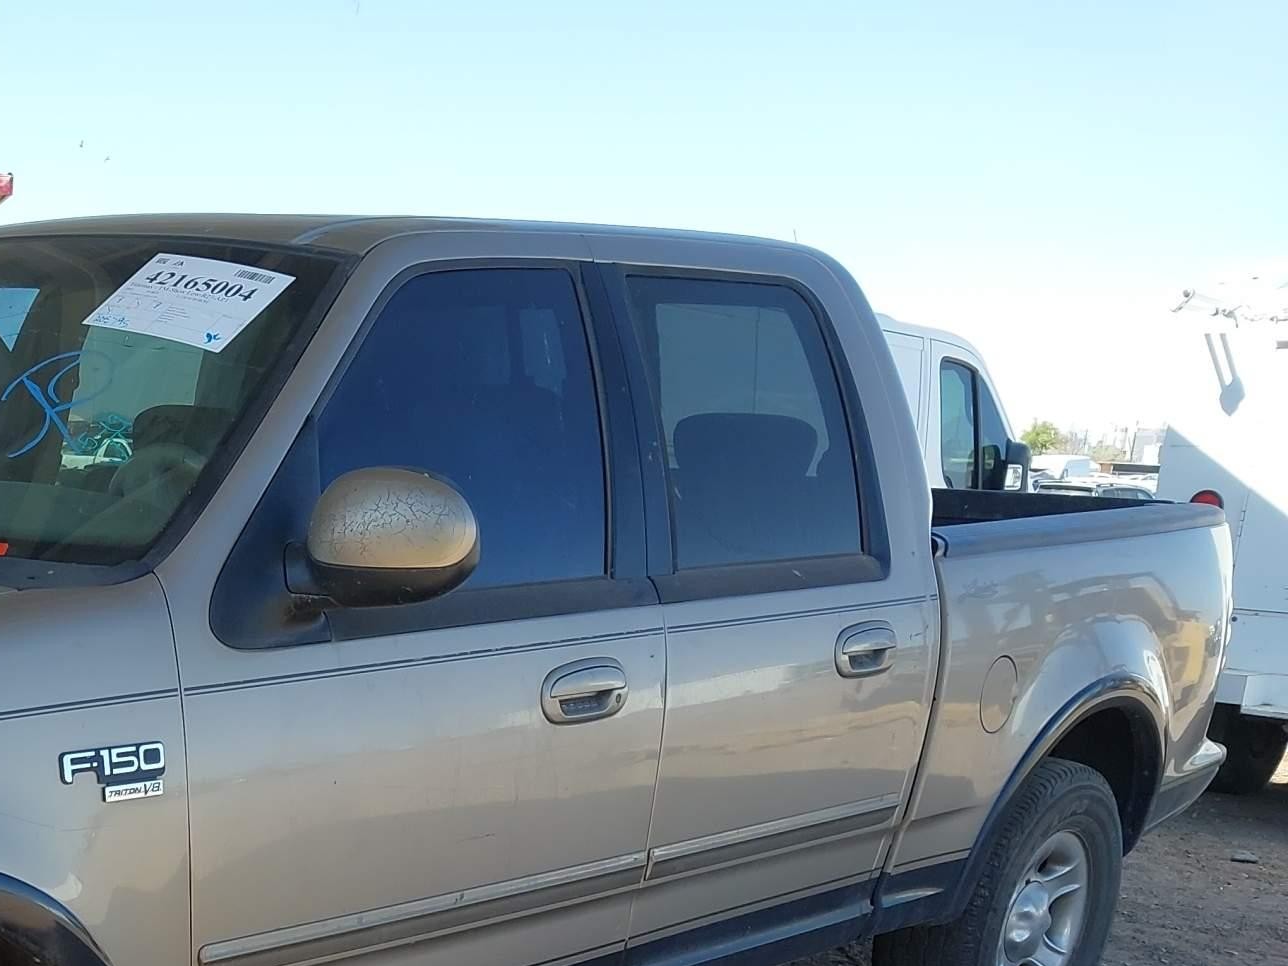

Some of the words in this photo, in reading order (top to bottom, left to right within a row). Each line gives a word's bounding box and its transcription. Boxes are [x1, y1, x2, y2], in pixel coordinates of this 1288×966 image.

[145, 270, 259, 302] 42165004
[62, 742, 166, 784] F-150
[107, 785, 143, 798] TRITON
[143, 782, 161, 796] V8
